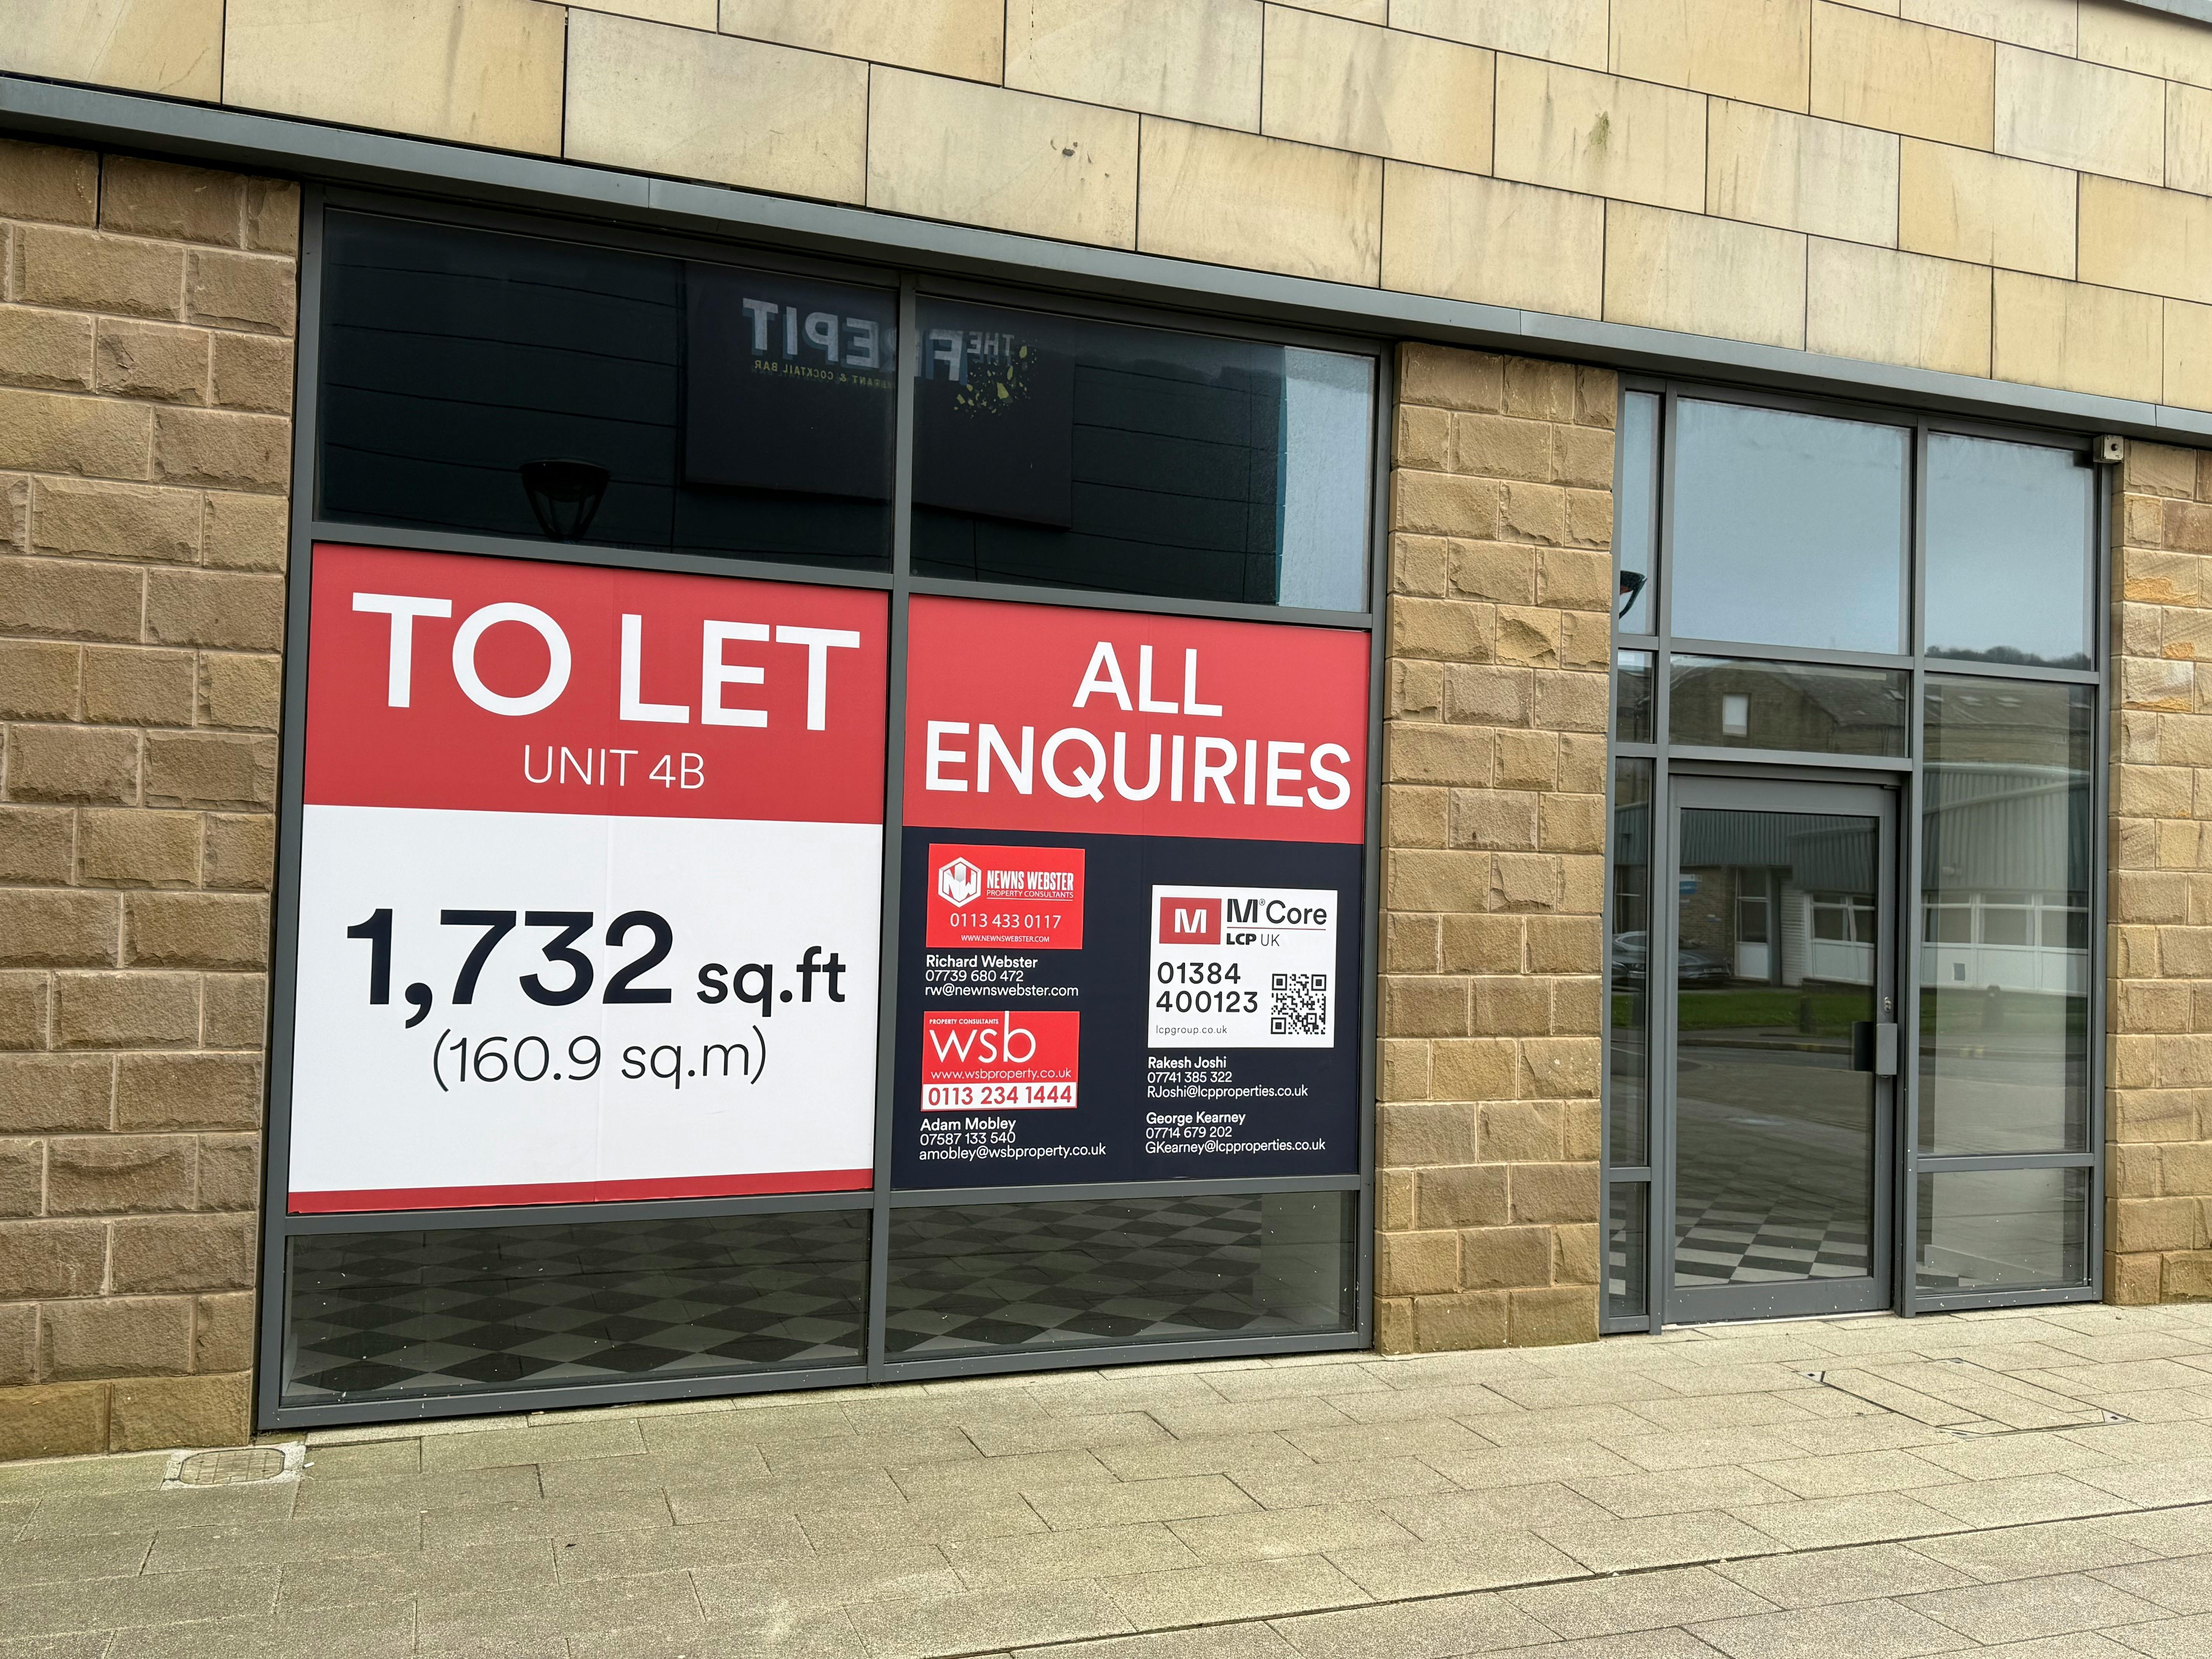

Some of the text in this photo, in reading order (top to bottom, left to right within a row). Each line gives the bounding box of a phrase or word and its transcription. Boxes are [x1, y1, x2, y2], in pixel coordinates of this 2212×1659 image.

[353, 592, 860, 730] TO LET
[1072, 641, 1222, 717] ALL
[524, 744, 704, 789] UNIT 4B
[925, 720, 1350, 810] ENQUIRIES
[987, 870, 1074, 890] NEWNS WEBSTER
[950, 913, 1061, 928] 0113 433 0117
[1174, 908, 1207, 933] M
[1266, 900, 1327, 925] Core
[1226, 933, 1279, 946] LCP UK
[347, 908, 846, 1029] 1,732 sq.ft
[926, 955, 1037, 968] Richard Webster
[926, 970, 1024, 982] 07739 680 472
[1158, 962, 1240, 984] 01384
[925, 984, 1079, 996] rw@newnswebster.com
[1156, 991, 1258, 1013] 400123
[929, 1011, 1036, 1063] wsb
[1156, 1025, 1227, 1036] lcpgroup.co.uk
[433, 1025, 766, 1092] (160.9 sq.m)
[1148, 1056, 1226, 1068] Rakesh Joshi
[931, 1068, 1071, 1080] www.wsbproperty.co.uk
[1147, 1072, 1232, 1083] 07741 385 322
[929, 1086, 1072, 1105] 0113 234 1444
[1147, 1085, 1308, 1099] RJoshi@lcpproperties.co.uk
[920, 1117, 1016, 1132] Adam Mobley
[1146, 1111, 1246, 1126] George Kearney
[920, 1132, 1015, 1146] 07587 133 540
[1146, 1127, 1232, 1139] 07714 679 202
[920, 1143, 1106, 1161] amobley@wsbproperty.co.uk
[1146, 1139, 1325, 1155] GKearney@lcpproperties.co.uk
